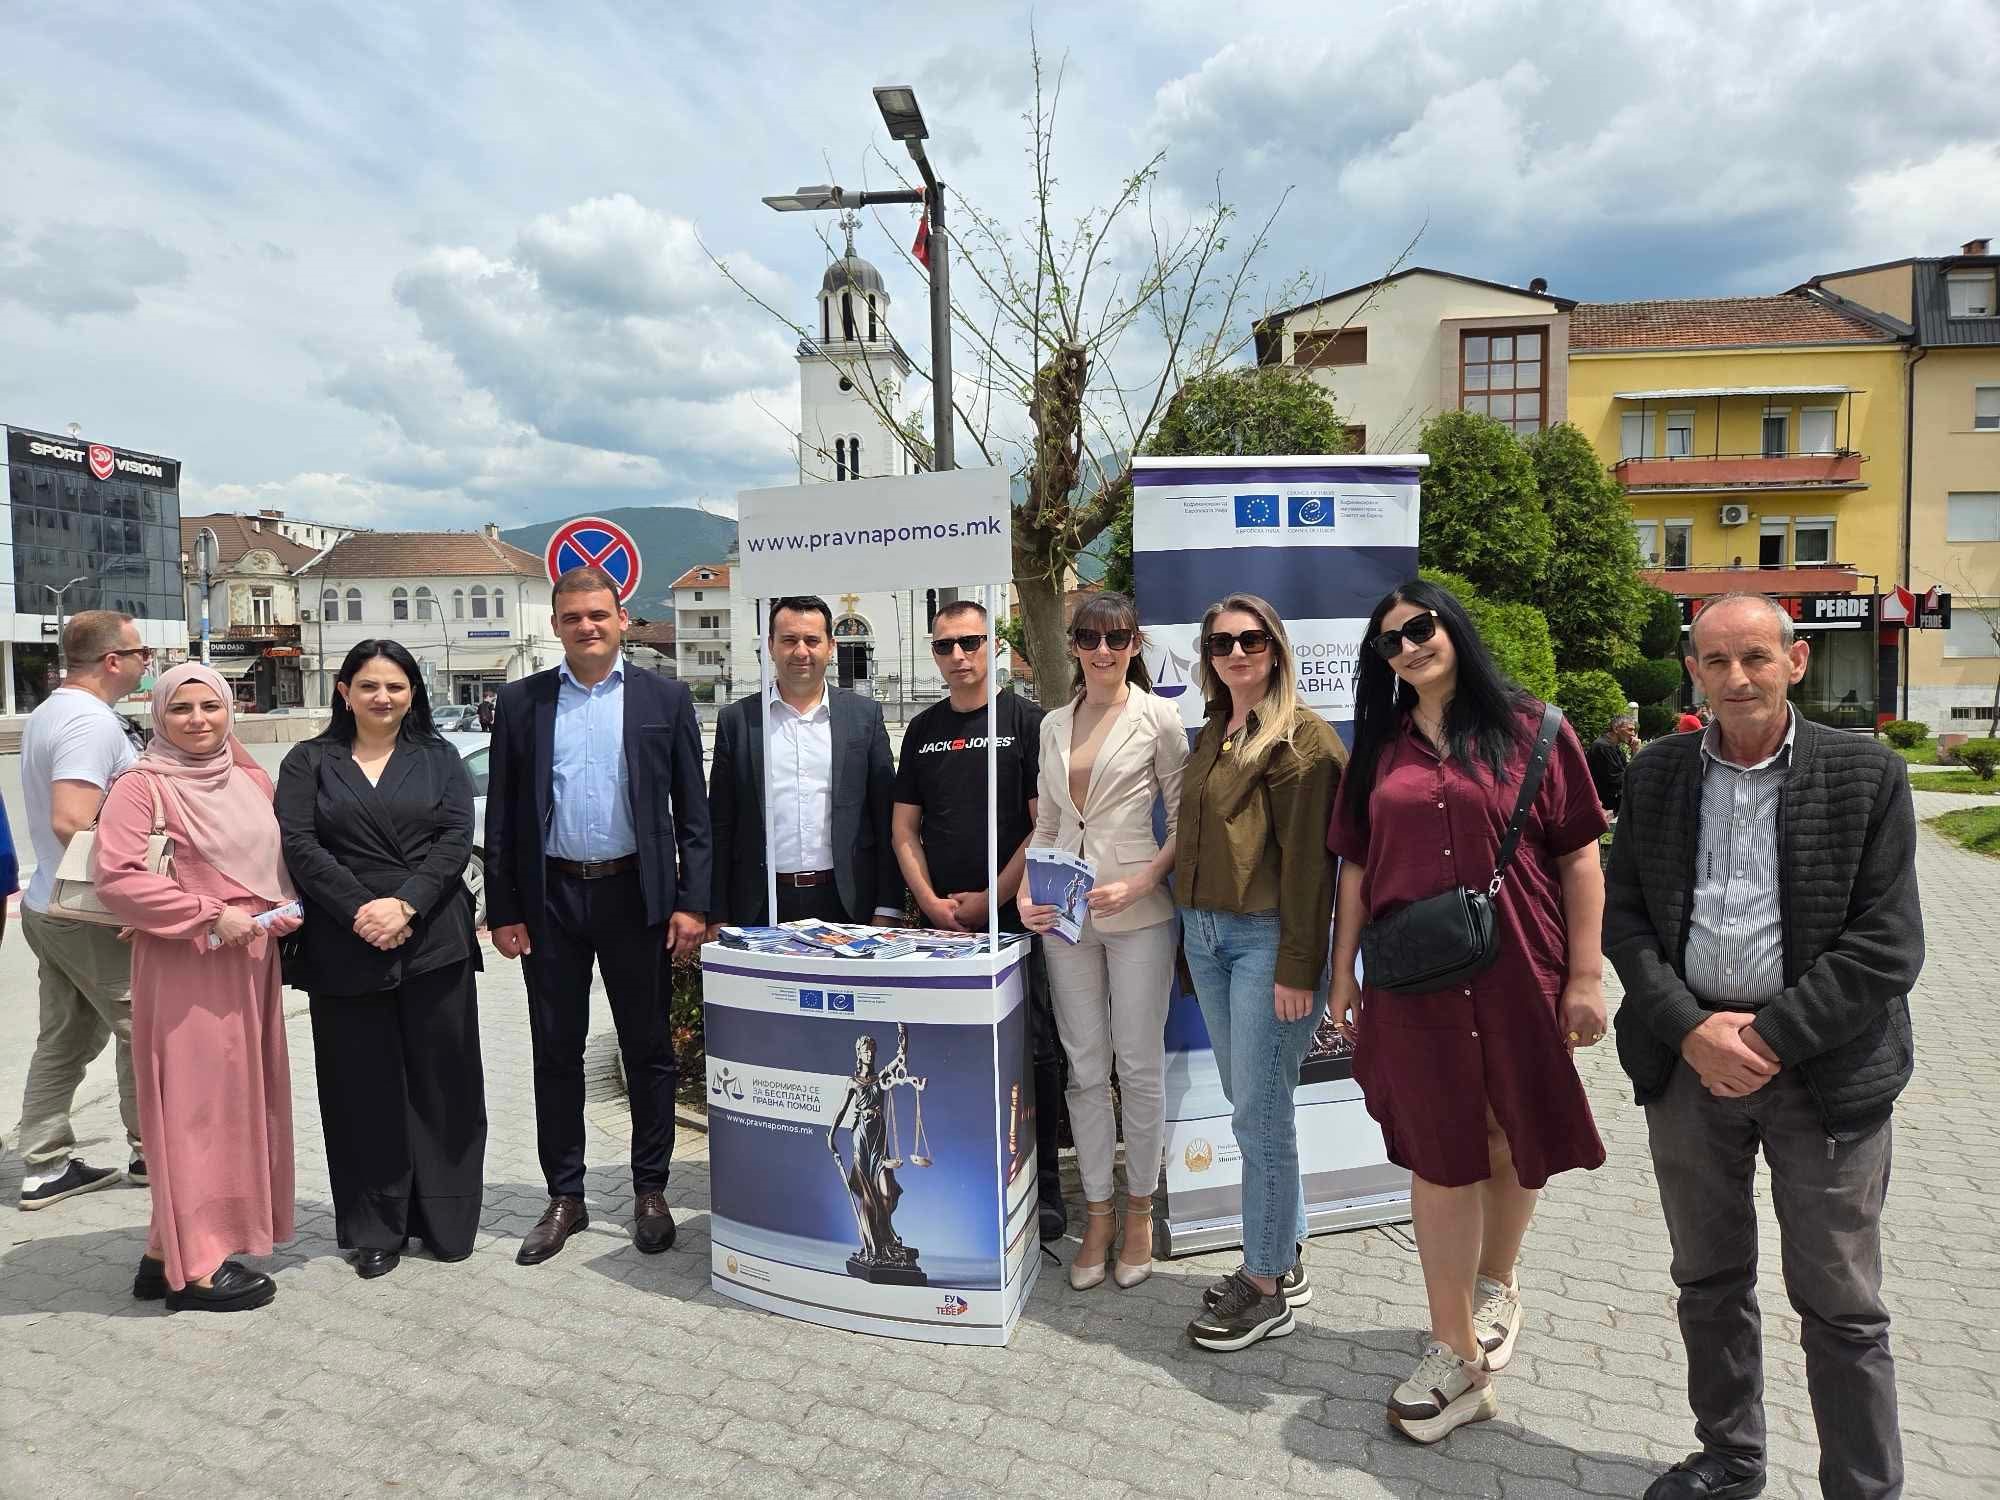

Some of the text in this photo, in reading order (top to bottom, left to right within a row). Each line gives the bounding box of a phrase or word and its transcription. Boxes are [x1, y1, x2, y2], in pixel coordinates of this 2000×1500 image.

[29, 441, 163, 478] SPORT VISION
[747, 515, 1001, 552] www.pravnapomos.mk
[1815, 598, 1869, 618] PERDE
[1920, 614, 1943, 628] PERDE
[1296, 678, 1345, 692] АВНА
[918, 739, 953, 754] JACK
[752, 1077, 820, 1094] ИНФОРМИРАЈ СЕ
[764, 1088, 820, 1103] БЕСПЛАТНА
[752, 1096, 821, 1112] ПРАВНА ПОМОШ
[726, 1114, 814, 1135] www.pravnapomos.mk
